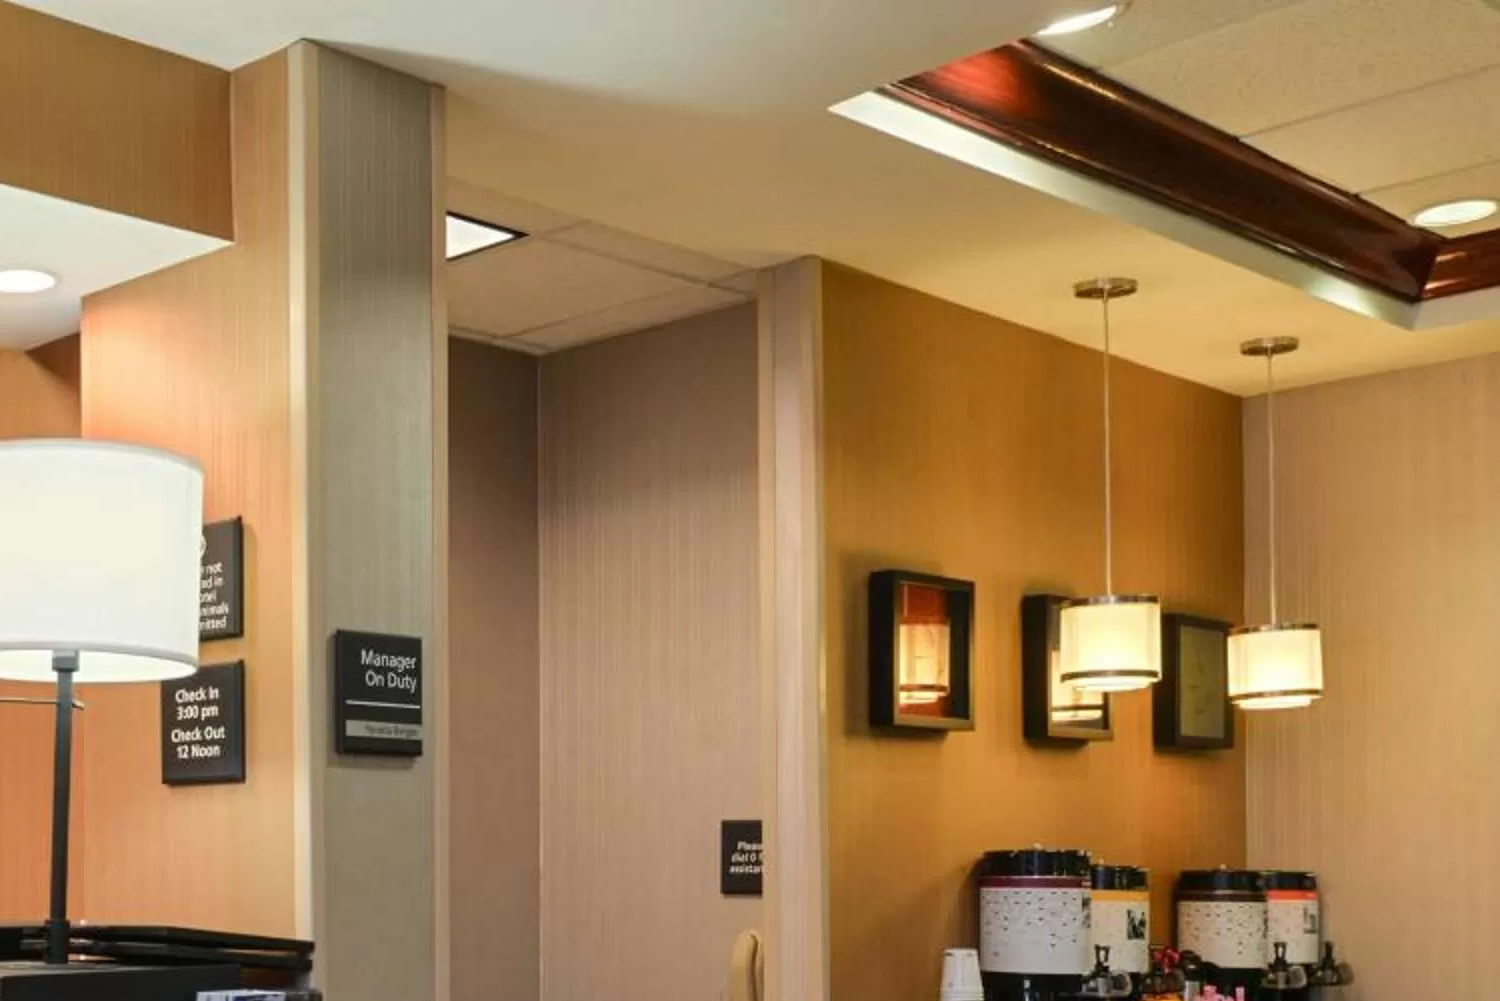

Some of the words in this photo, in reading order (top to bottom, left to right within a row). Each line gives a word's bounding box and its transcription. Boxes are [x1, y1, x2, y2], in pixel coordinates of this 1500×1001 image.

[200, 602, 229, 616] nimals
[361, 648, 417, 673] Manager
[365, 669, 385, 687] On
[387, 671, 417, 694] Duty
[175, 687, 207, 703] Check
[209, 686, 220, 700] In
[176, 705, 199, 720] 3:00
[201, 705, 219, 721] pm
[171, 726, 202, 743] Check
[204, 725, 226, 740] Out
[176, 744, 189, 759] 12
[191, 744, 221, 758] Noon
